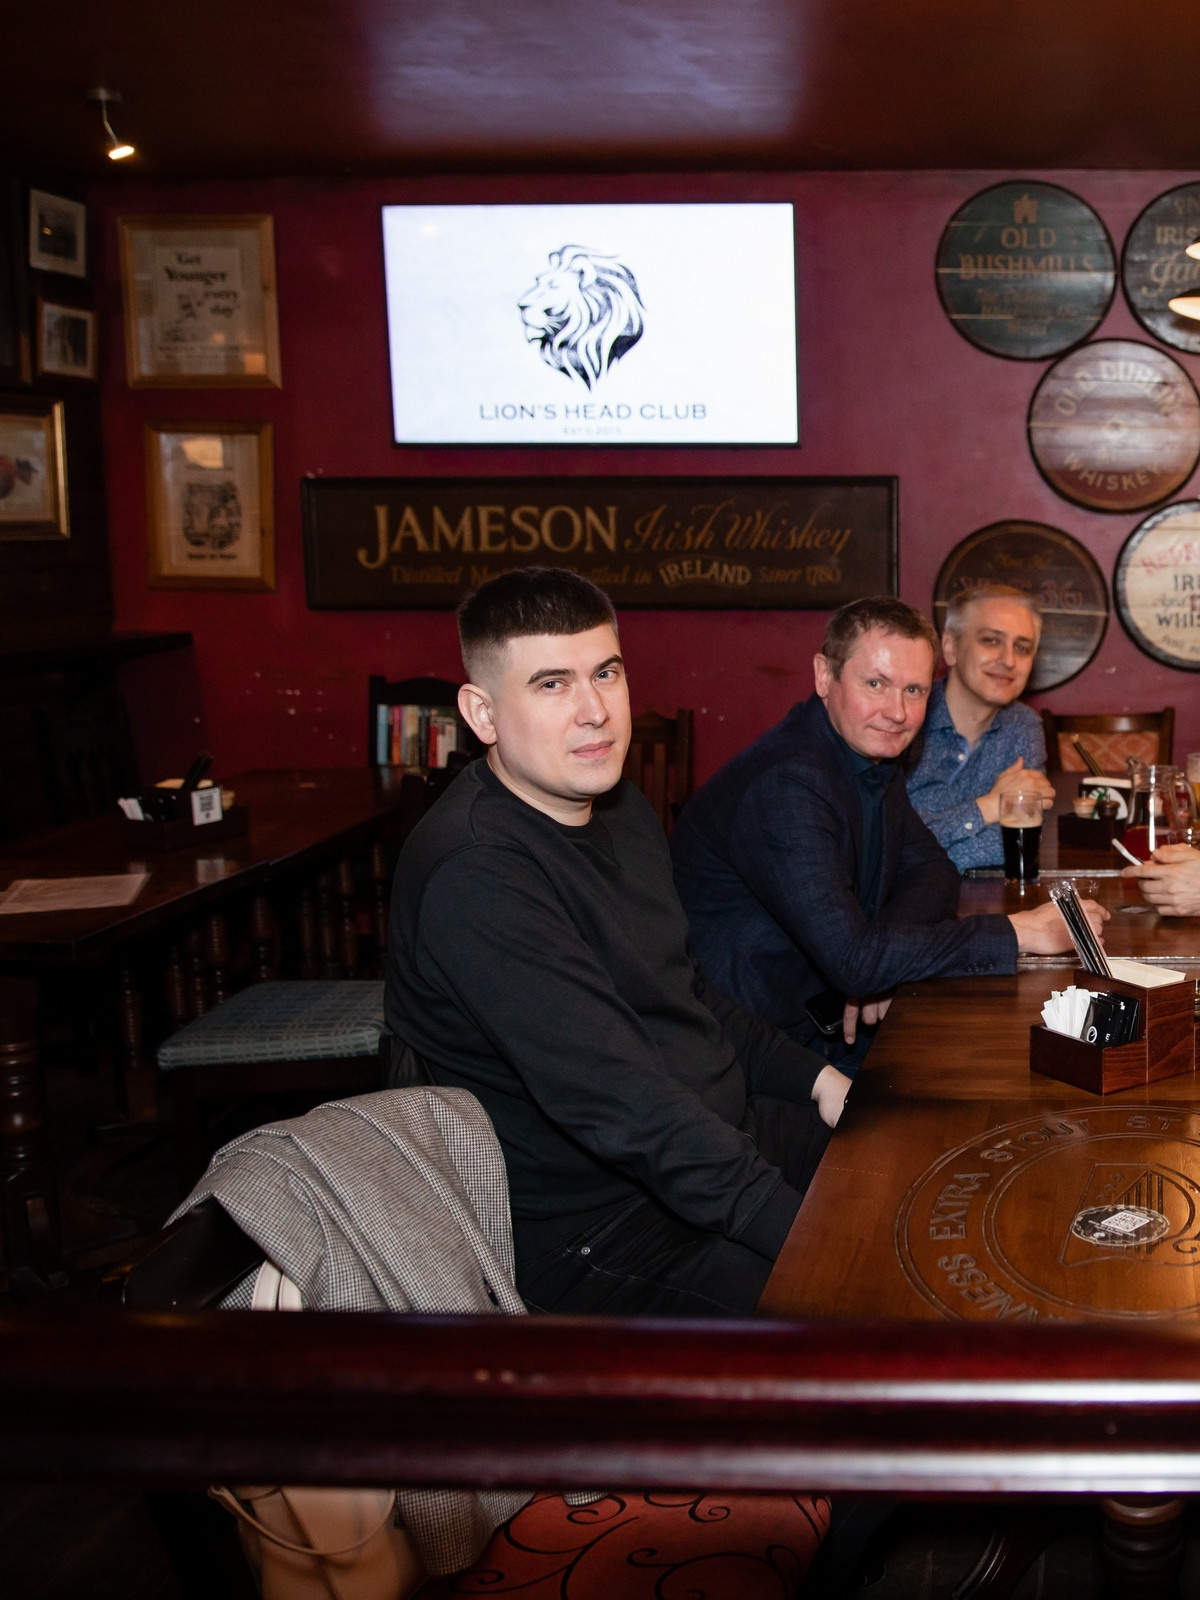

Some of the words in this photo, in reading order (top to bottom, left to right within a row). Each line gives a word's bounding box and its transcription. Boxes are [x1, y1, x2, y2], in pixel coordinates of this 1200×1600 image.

[1000, 227, 1057, 249] OLD
[1155, 225, 1197, 245] IRIS
[959, 253, 1096, 280] BUSHMILLS
[479, 403, 557, 420] LION'S
[564, 403, 632, 420] HEAD
[639, 402, 708, 420] CLUB
[1055, 371, 1097, 416] OLD
[1064, 452, 1161, 491] WHISKEY
[356, 505, 619, 569] JAMESON
[623, 499, 730, 553] Irish
[724, 501, 853, 562] Whiskey
[658, 557, 752, 588] IRELAND
[980, 1118, 1089, 1162] STOUT
[1126, 1115, 1182, 1130] ST
[929, 1173, 990, 1240] EXTRA
[937, 1253, 1040, 1320] NESS
